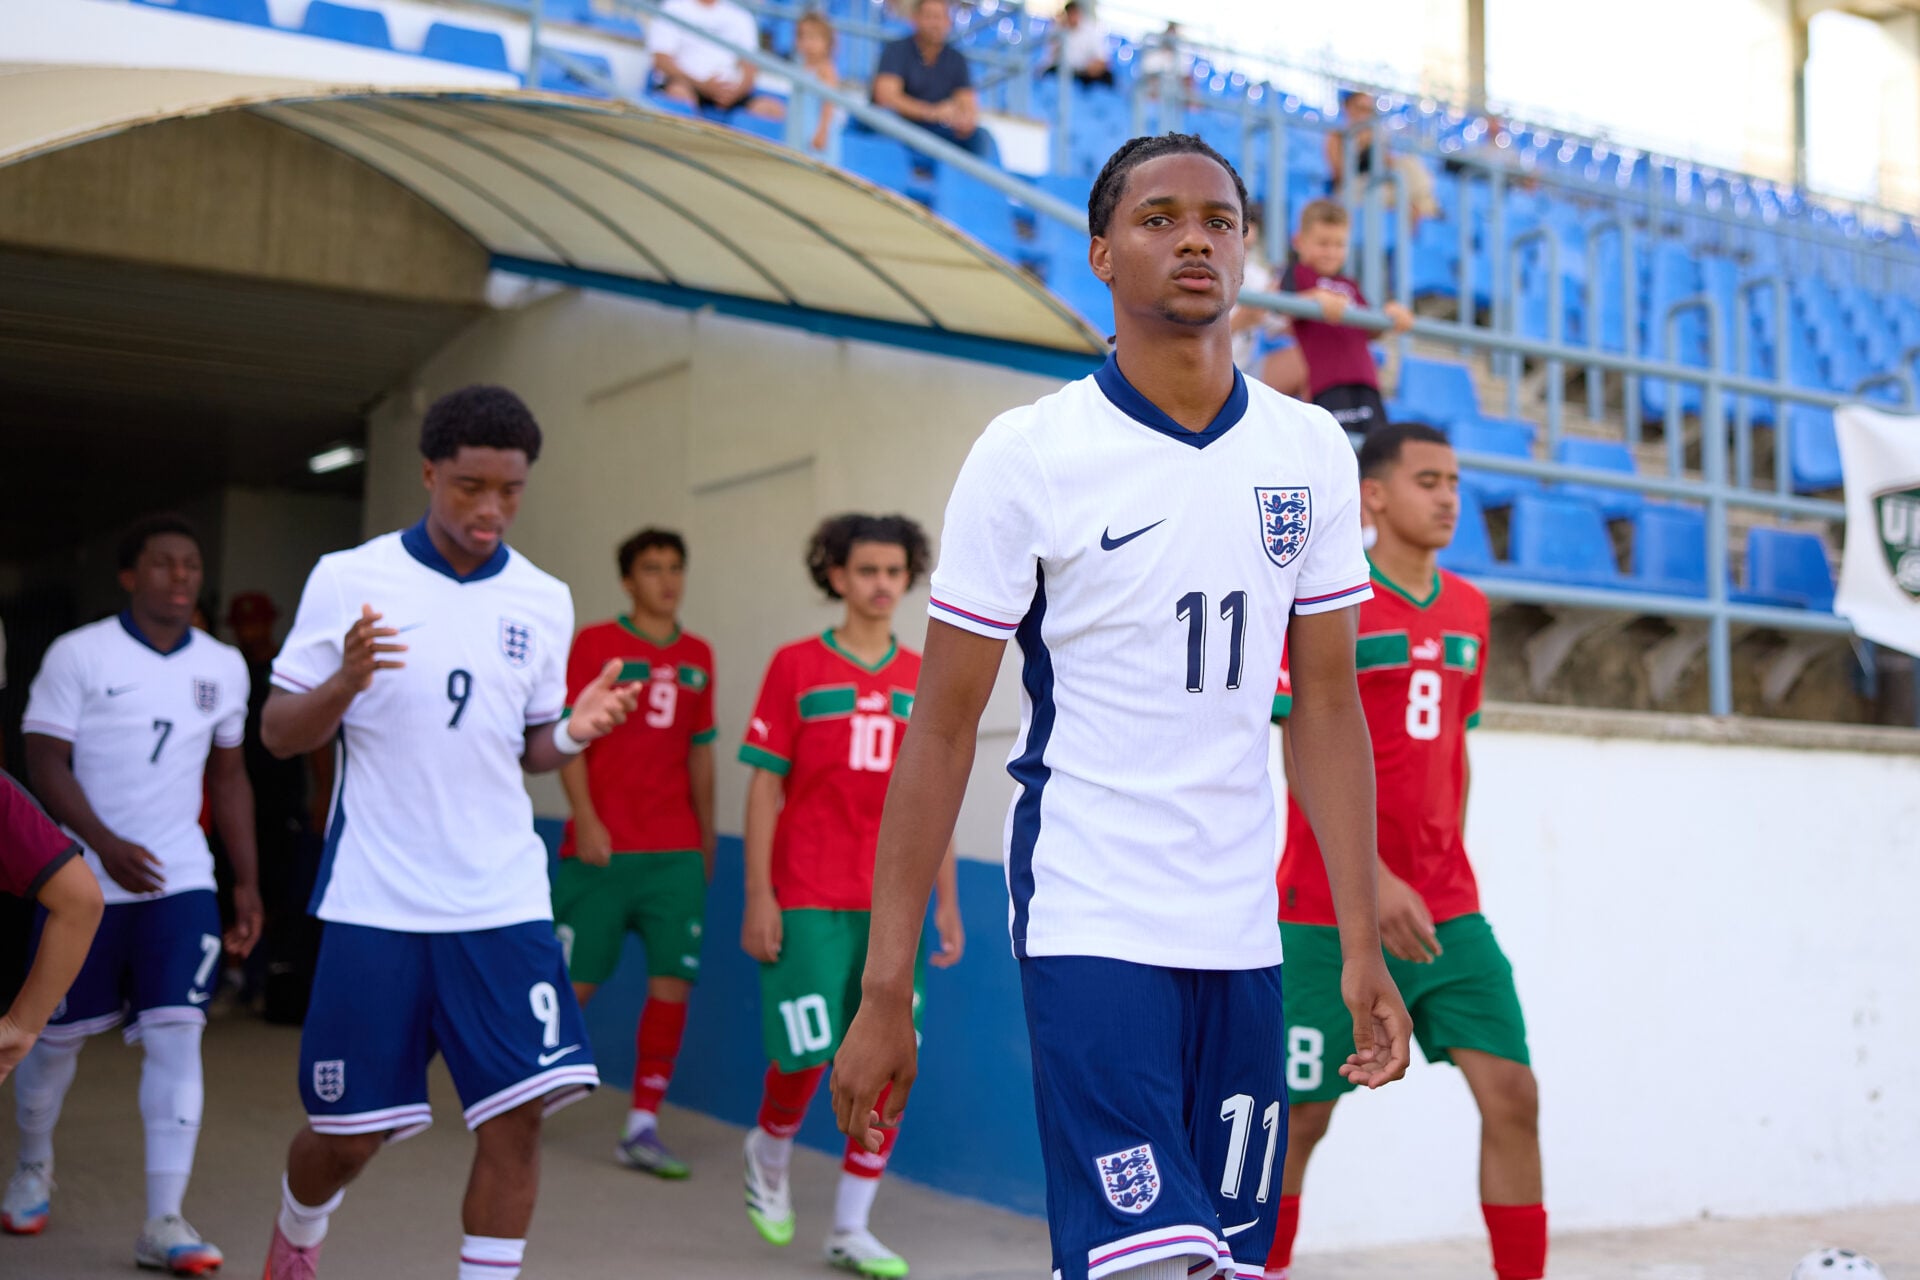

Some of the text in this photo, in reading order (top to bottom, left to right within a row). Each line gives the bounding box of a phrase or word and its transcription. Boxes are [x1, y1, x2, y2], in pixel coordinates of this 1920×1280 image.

[1176, 591, 1247, 693] 11
[447, 669, 473, 731] 9
[645, 680, 678, 729] 9
[1406, 669, 1442, 740] 8
[150, 718, 173, 765] 7
[848, 713, 895, 773] 10
[194, 932, 222, 989] 7
[529, 981, 560, 1049] 9
[779, 993, 833, 1057] 10
[1286, 1025, 1325, 1092] 8
[1220, 1093, 1280, 1204] 11
